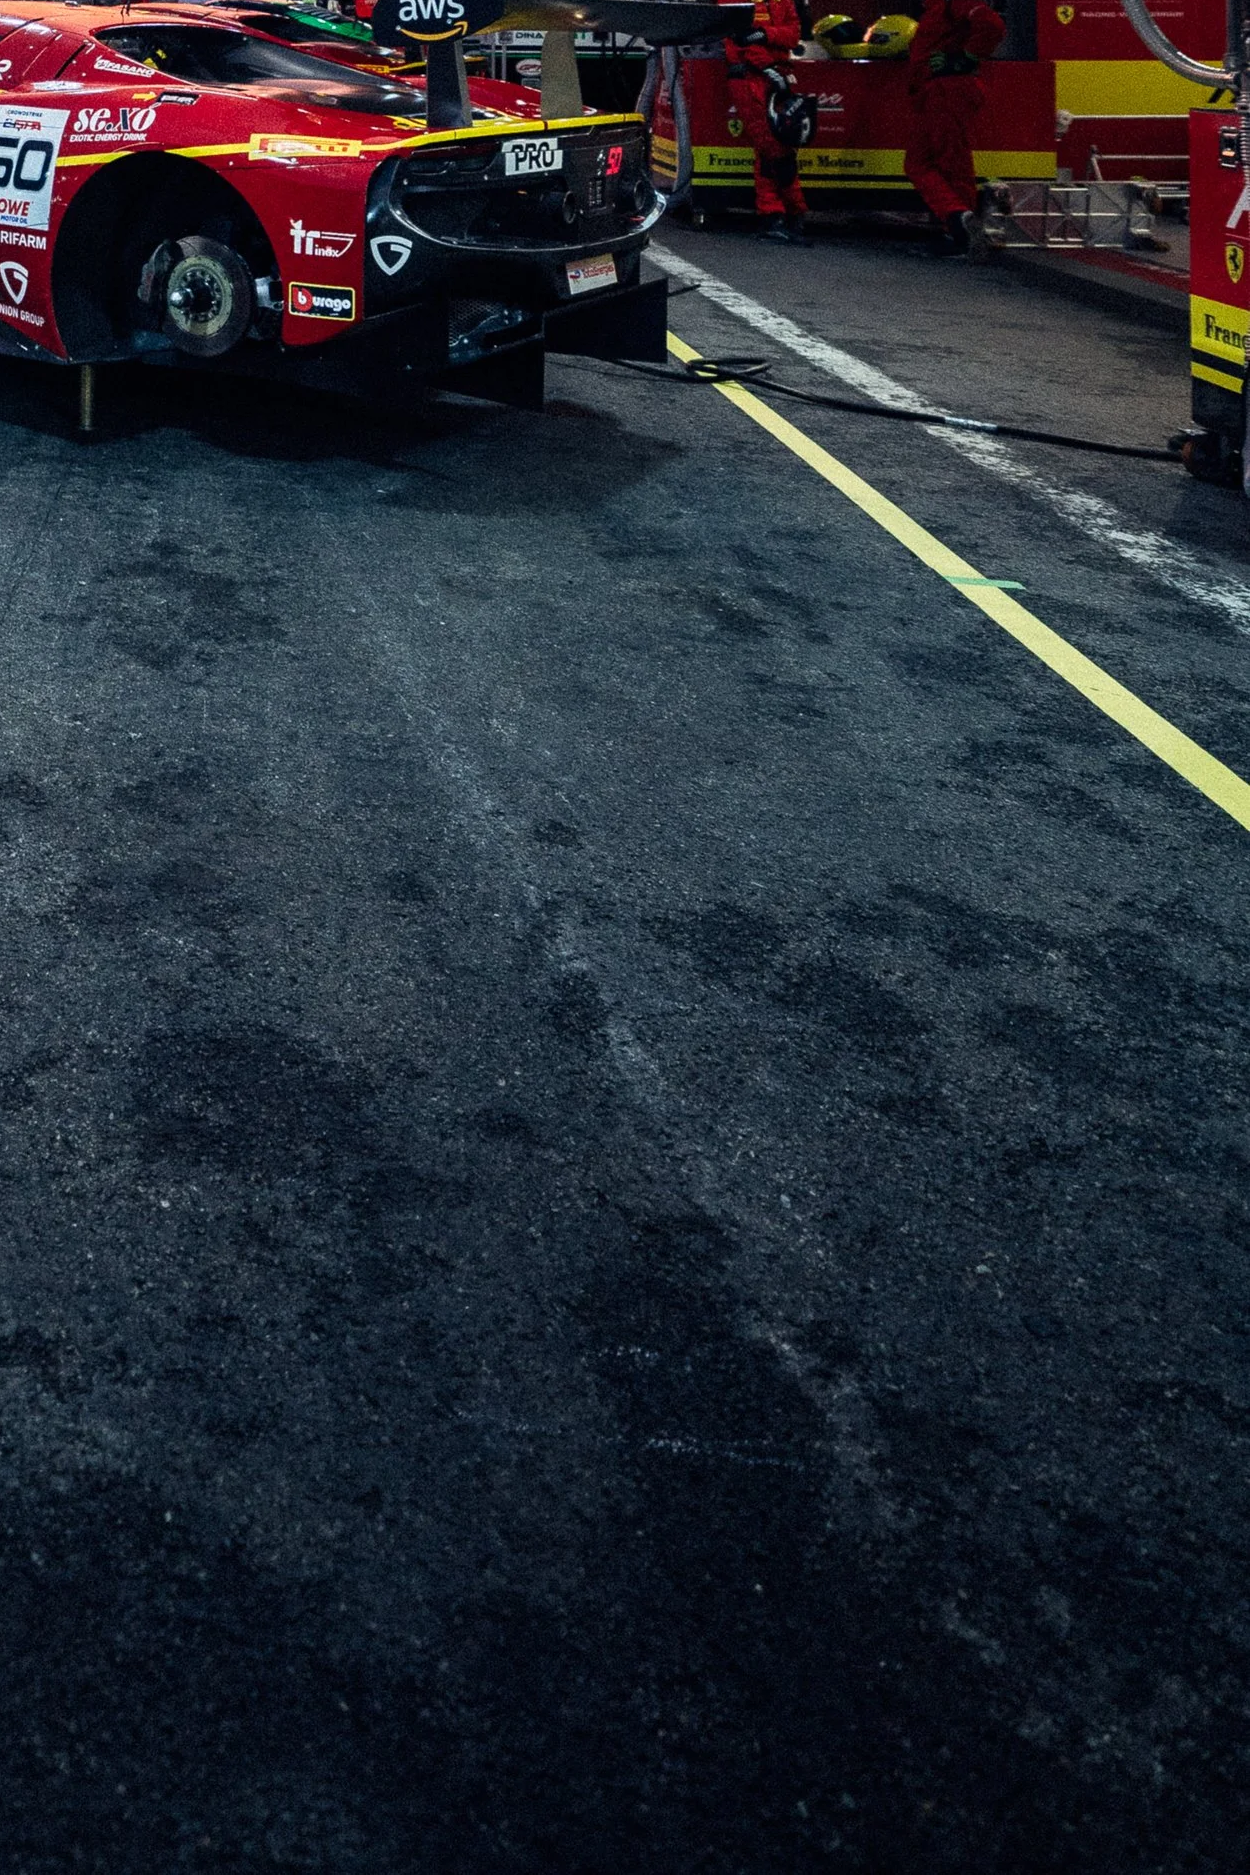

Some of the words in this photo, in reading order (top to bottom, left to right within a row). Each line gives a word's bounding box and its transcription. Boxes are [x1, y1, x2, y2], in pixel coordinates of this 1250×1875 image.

[70, 132, 94, 143] EXOTIC
[94, 132, 123, 142] ENERGY
[122, 132, 147, 142] DRINK
[512, 142, 555, 171] PRO
[1, 215, 19, 223] MOTOR
[19, 310, 45, 327] GROUP
